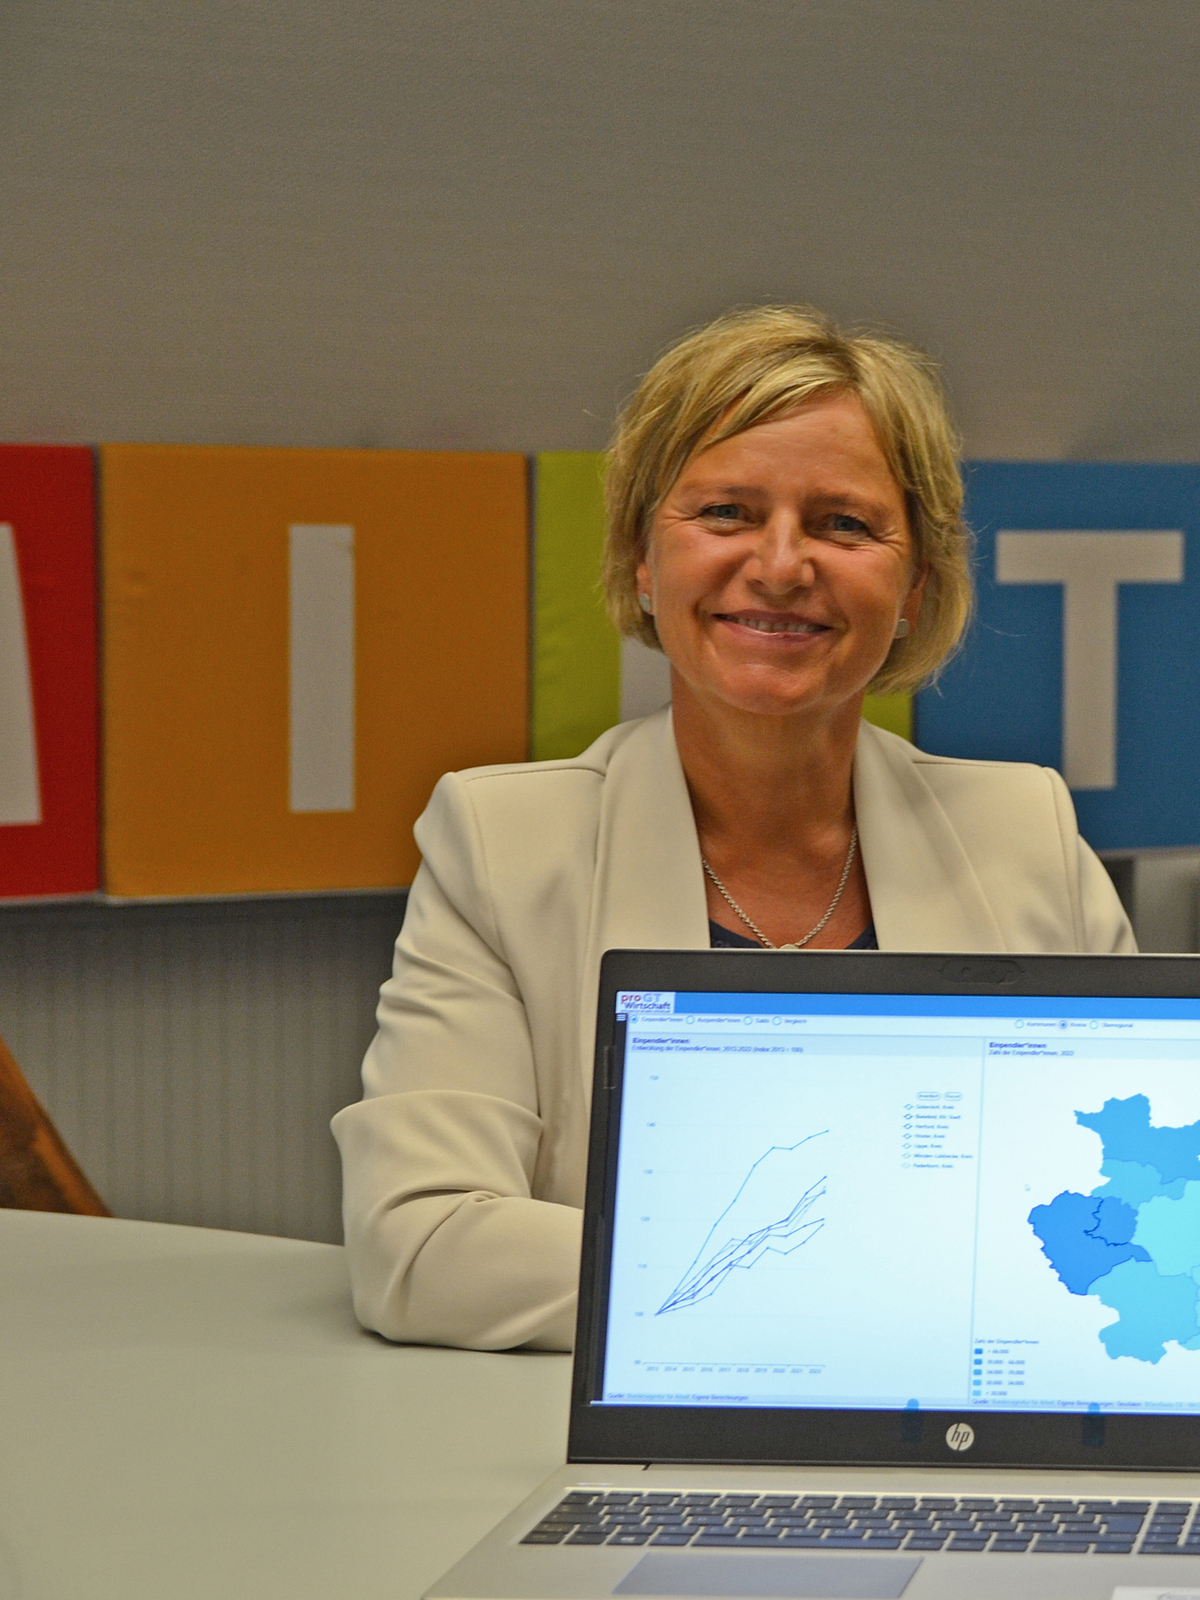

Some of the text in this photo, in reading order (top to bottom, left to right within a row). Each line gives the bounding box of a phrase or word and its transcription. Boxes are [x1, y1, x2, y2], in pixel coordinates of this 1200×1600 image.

[995, 530, 1184, 789] T
[620, 993, 662, 1004] pro GT
[624, 1001, 671, 1010] Wirtschaft
[950, 1423, 970, 1450] hp
